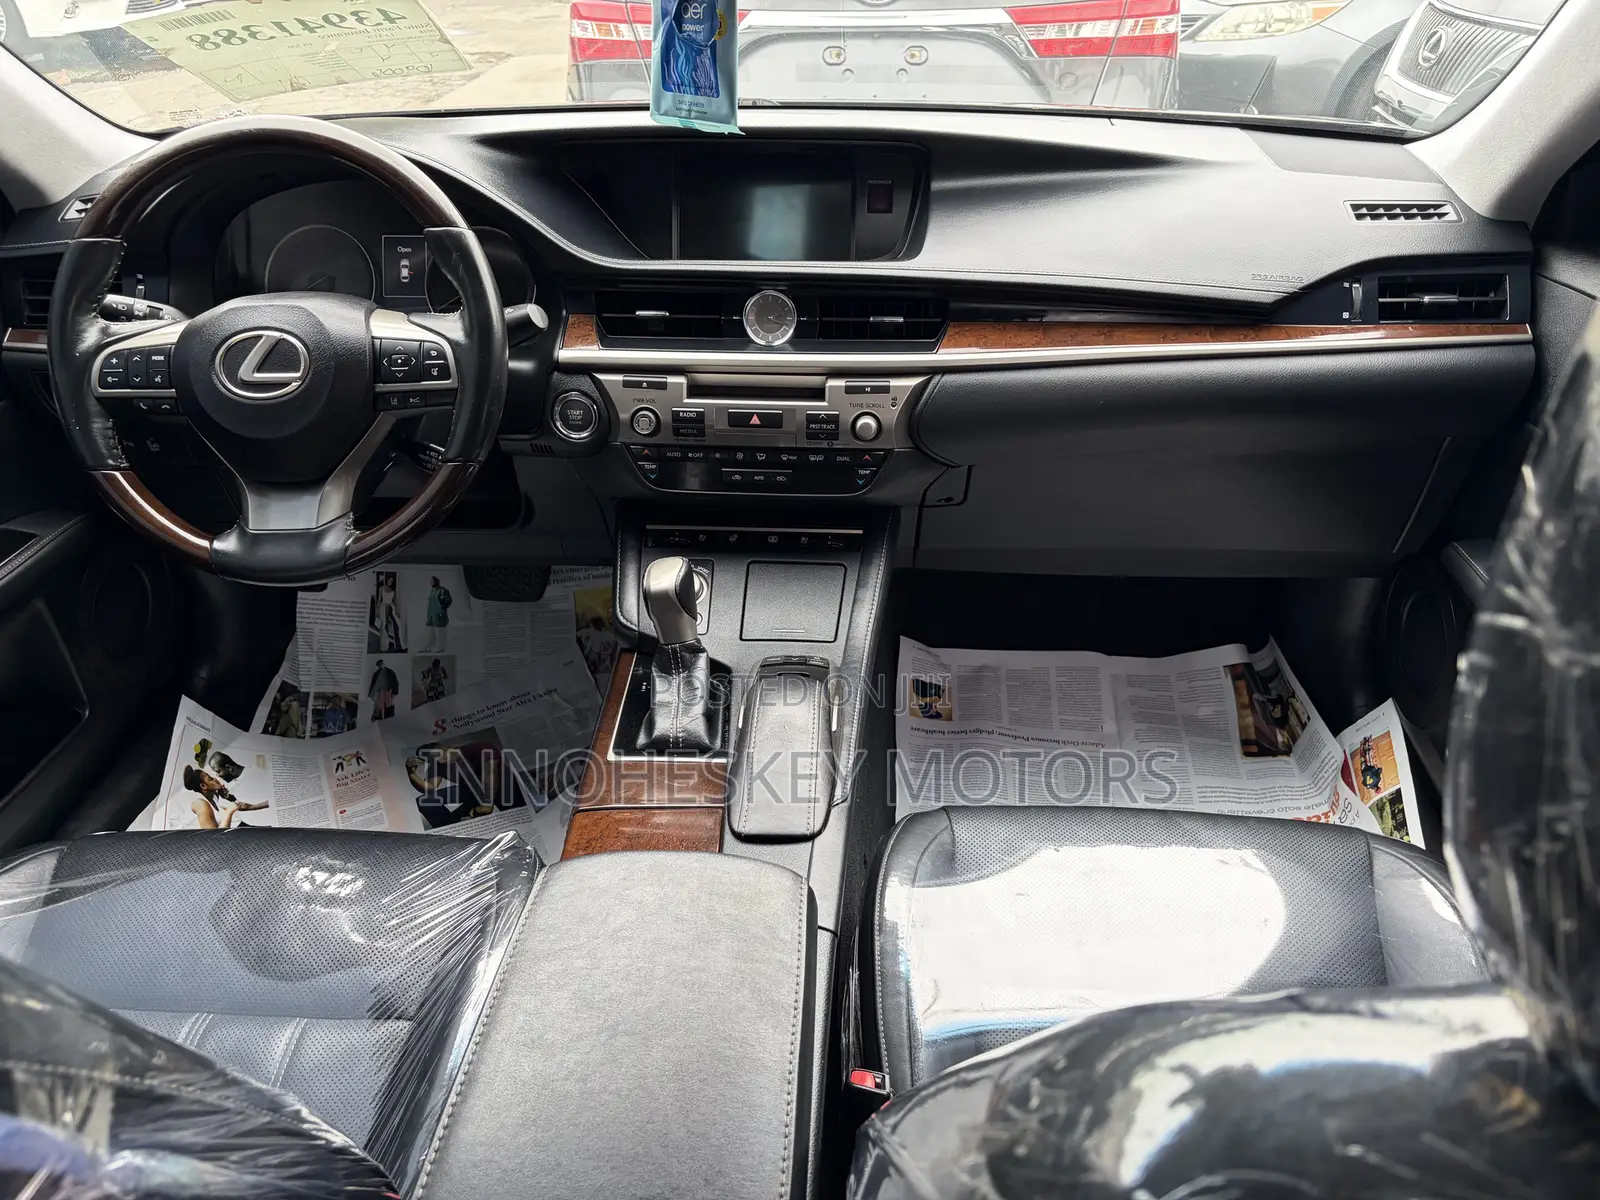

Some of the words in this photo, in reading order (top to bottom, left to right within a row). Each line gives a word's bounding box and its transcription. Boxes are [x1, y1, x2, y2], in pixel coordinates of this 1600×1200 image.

[681, 3, 707, 20] aer
[681, 23, 705, 32] power
[397, 245, 412, 254] Open
[451, 712, 477, 724] things
[477, 707, 486, 715] to
[486, 699, 508, 711] know
[508, 690, 532, 703] about
[452, 711, 496, 729] Nollywood
[496, 704, 513, 715] Star
[515, 698, 533, 709] Alex
[909, 725, 946, 736] healthcare
[946, 728, 968, 736] better
[968, 726, 995, 736] pledges
[1030, 736, 1061, 746] becomes
[336, 775, 349, 783] Ask
[336, 780, 350, 789] Big
[350, 773, 373, 784] Sister
[1277, 805, 1302, 814] solo
